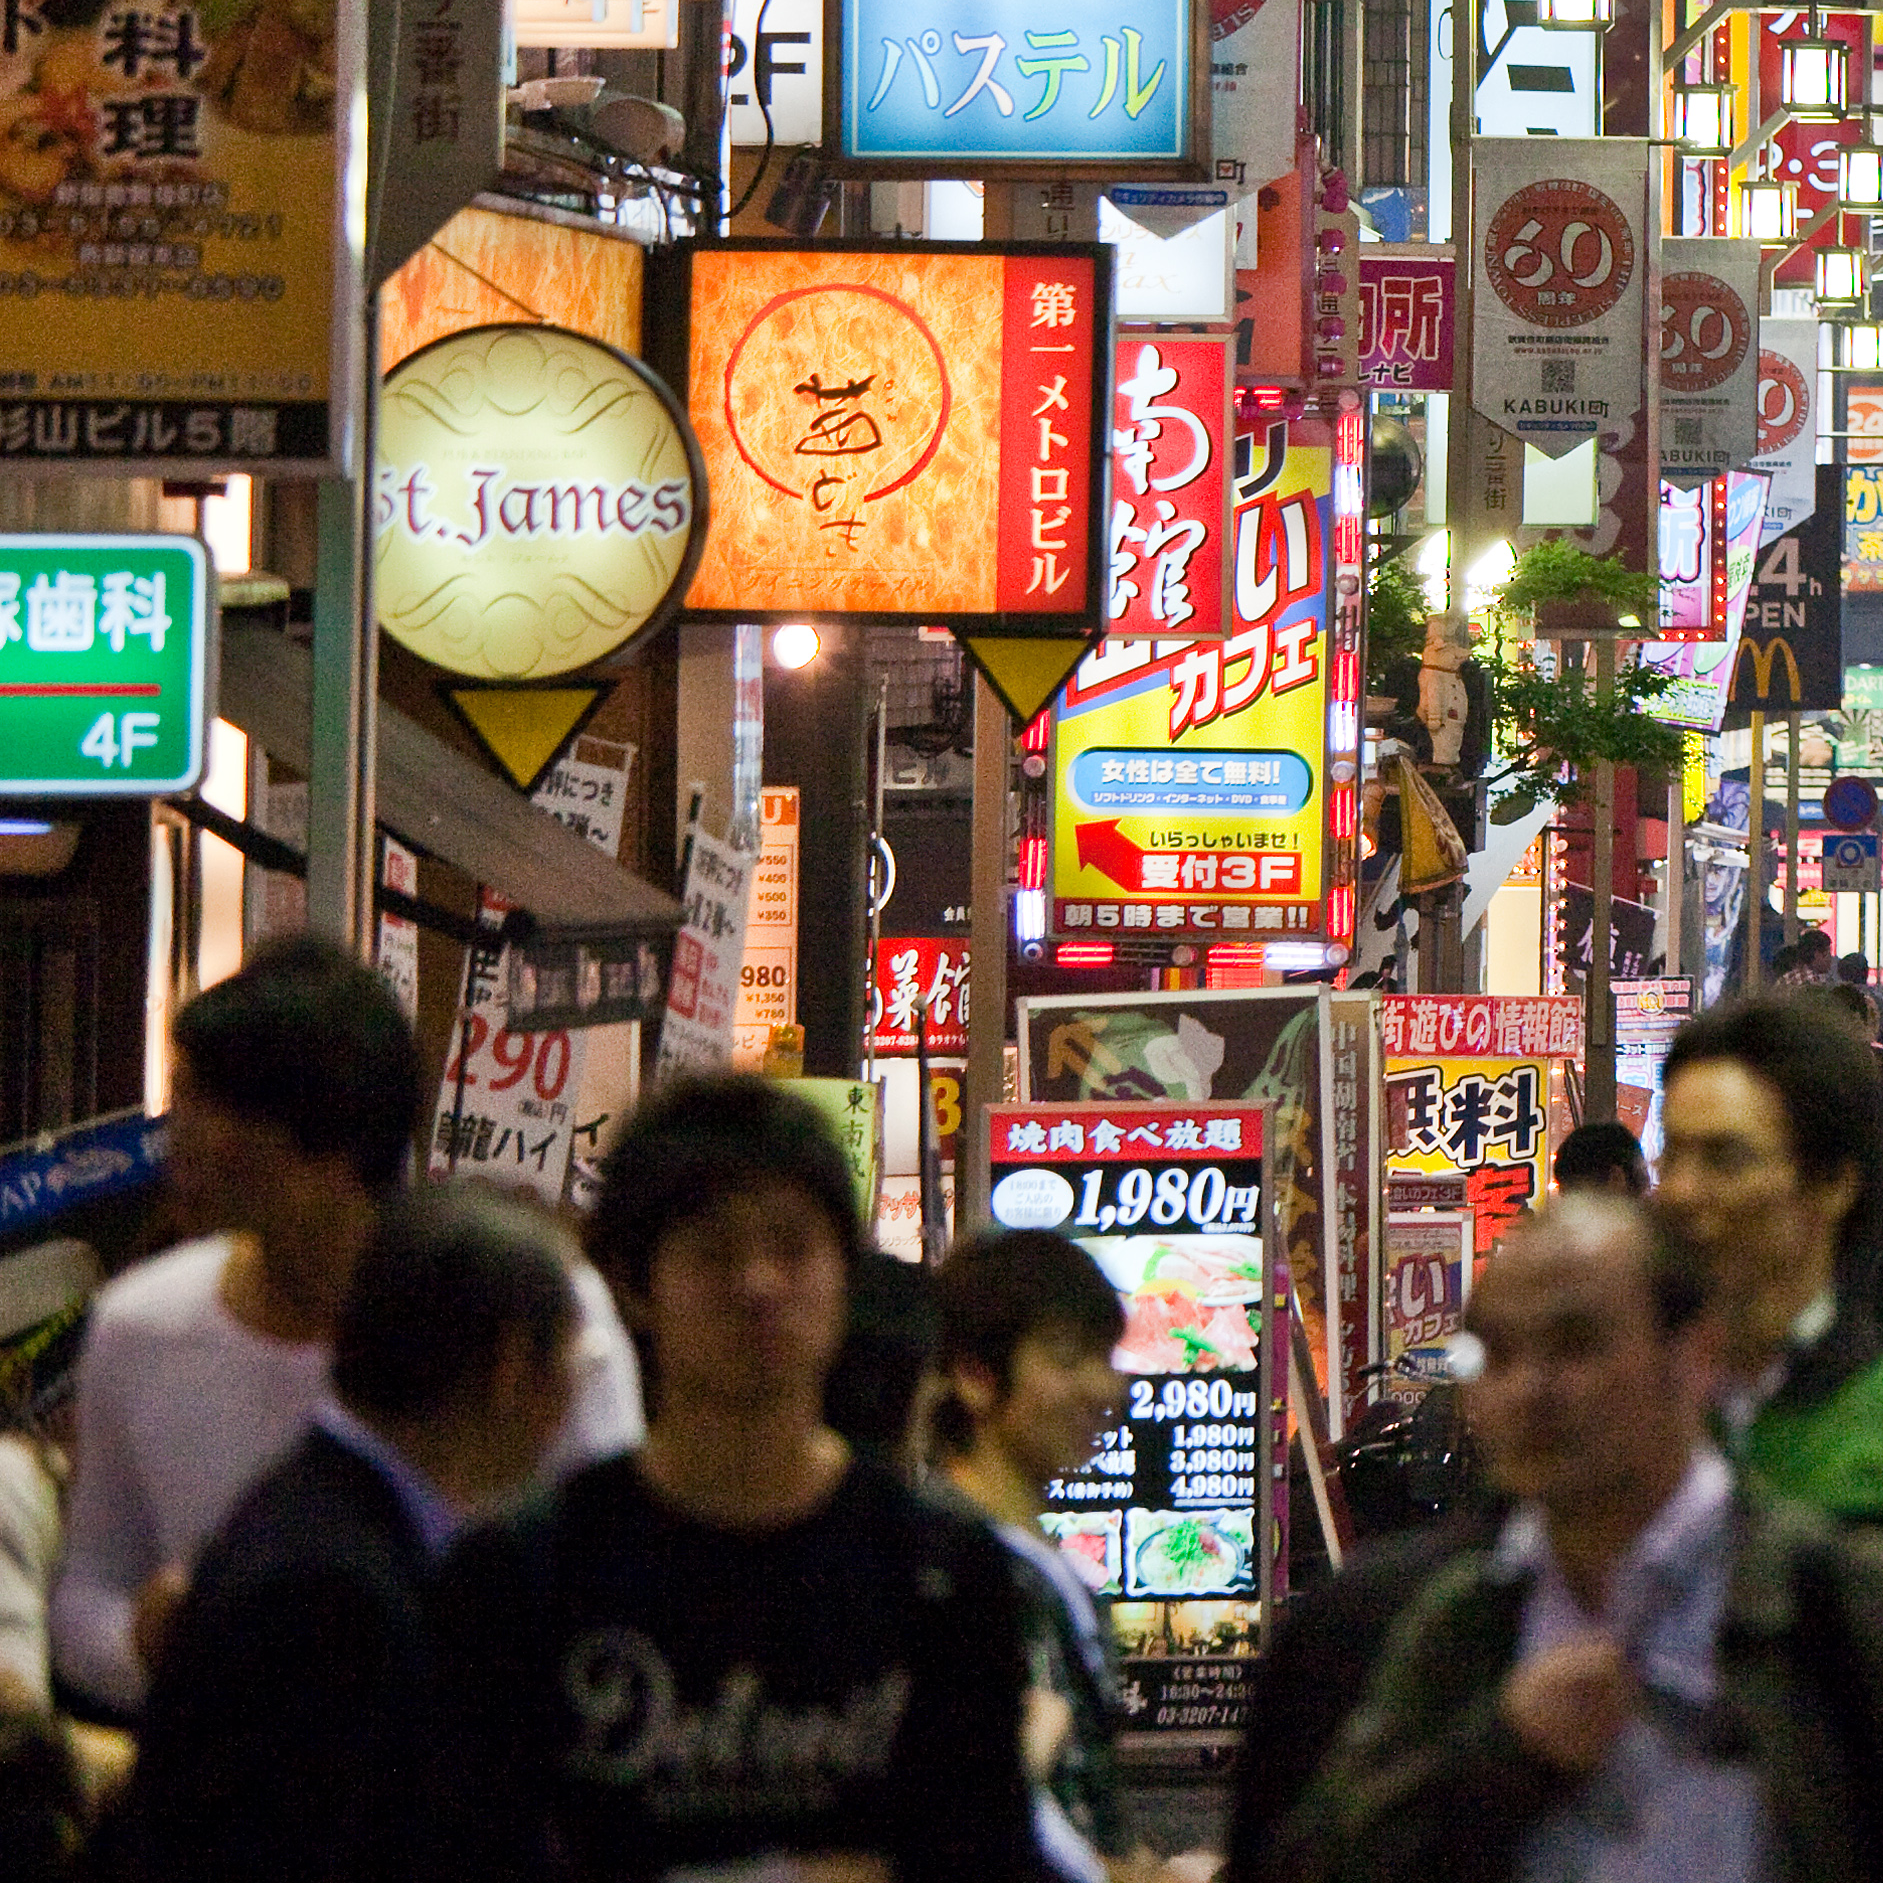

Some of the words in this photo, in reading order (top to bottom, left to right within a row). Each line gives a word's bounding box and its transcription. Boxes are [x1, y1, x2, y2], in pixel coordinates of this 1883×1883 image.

[866, 26, 1168, 124] パステル
[1504, 218, 1613, 287] 60
[1027, 281, 1077, 599] 第一メトロビル
[452, 465, 690, 552] James
[1170, 613, 1318, 741] カフェ
[80, 714, 162, 767] 4F
[1101, 758, 1282, 786] 女性は全て無料!
[1147, 830, 1299, 850] いらっしゃいませ!
[1140, 854, 1295, 892] 受付3F
[1064, 903, 1309, 931] 朝5時まで営業!!
[1005, 1117, 1243, 1156] 焼肉食べ放題
[1074, 1167, 1260, 1229] 1,980円
[1130, 1377, 1257, 1422] 2,980円
[1173, 1424, 1255, 1448] 1,980円
[1170, 1449, 1255, 1474] 3,980円
[1170, 1474, 1255, 1502] 4,980円
